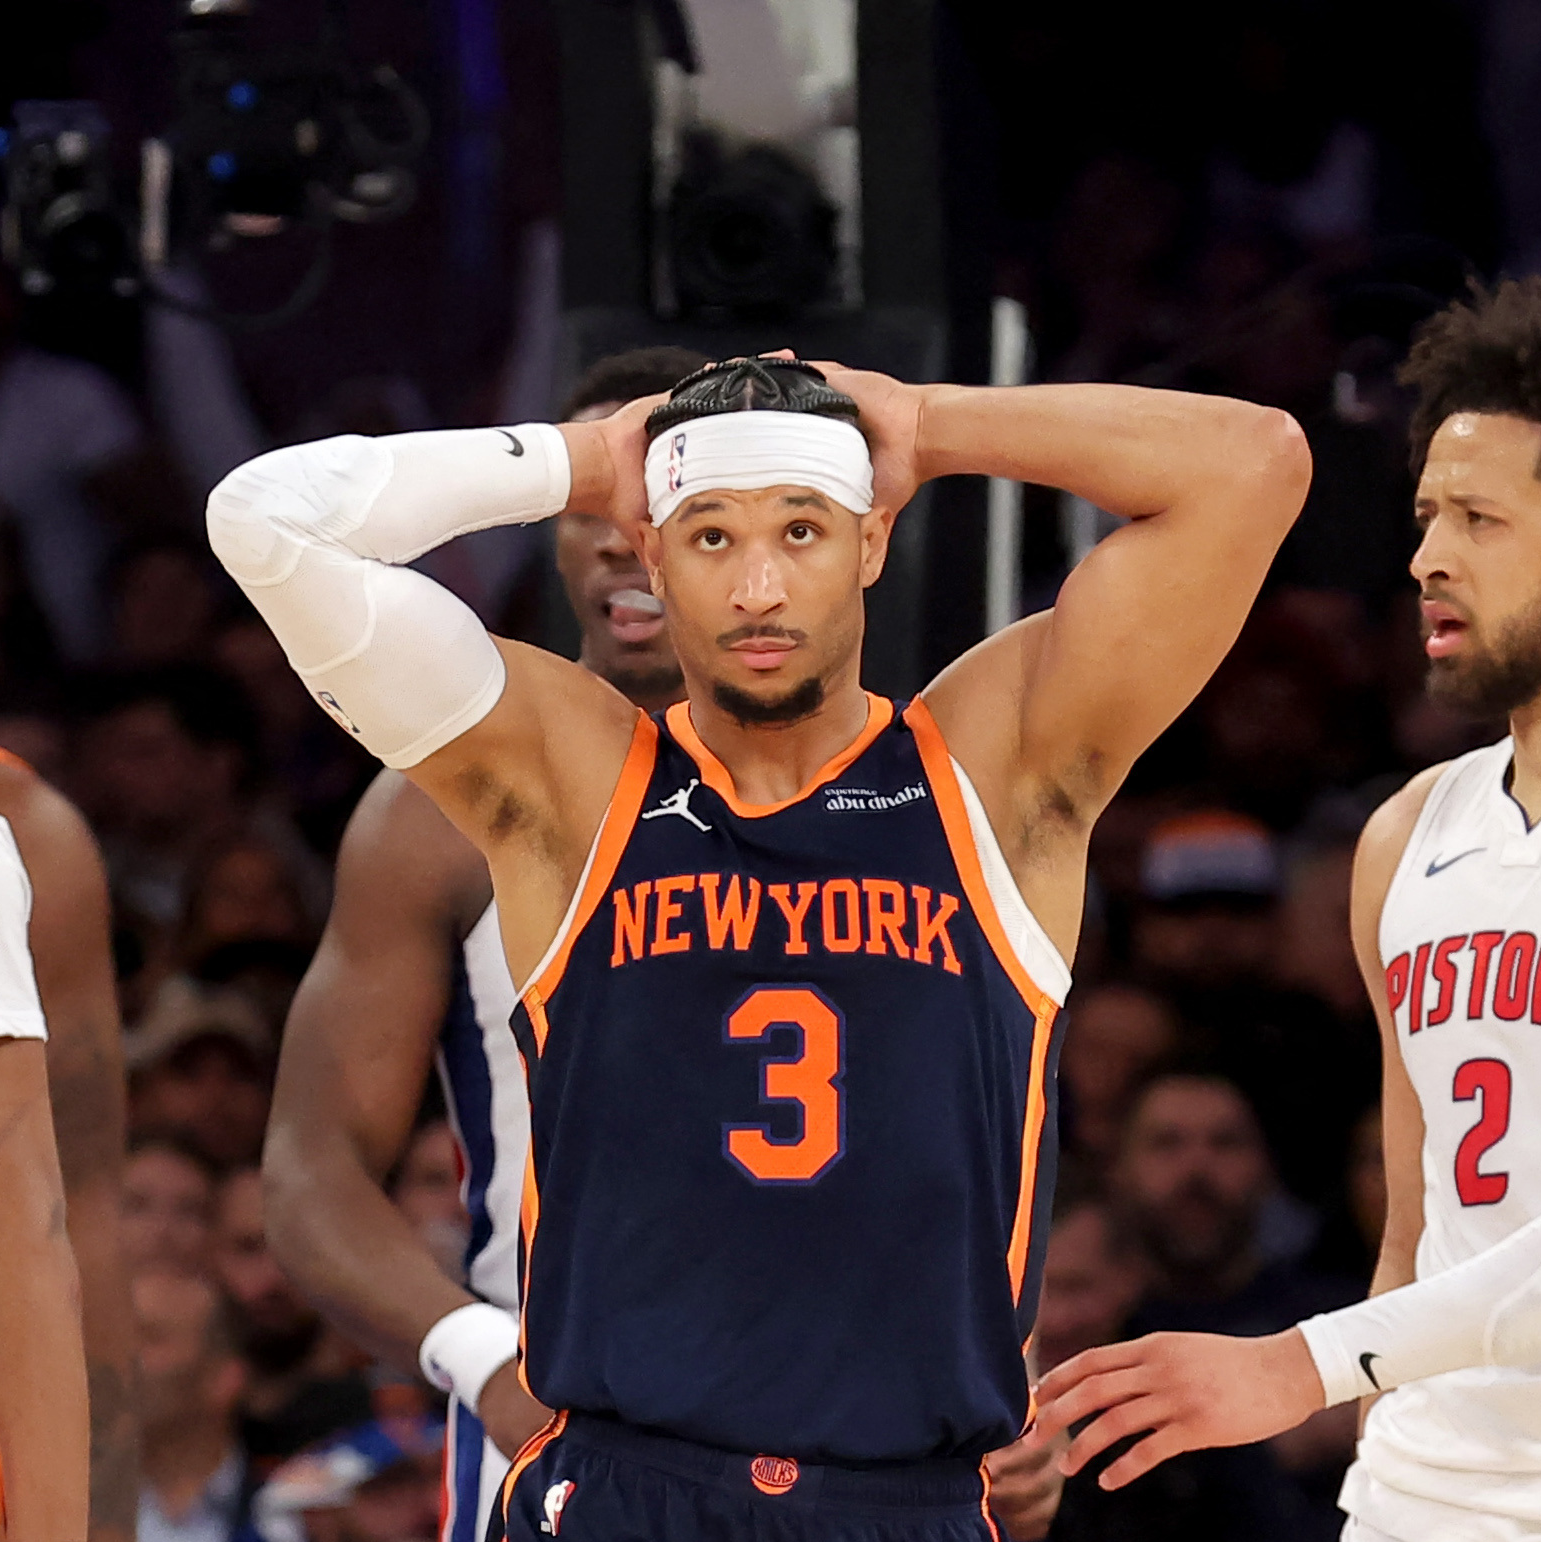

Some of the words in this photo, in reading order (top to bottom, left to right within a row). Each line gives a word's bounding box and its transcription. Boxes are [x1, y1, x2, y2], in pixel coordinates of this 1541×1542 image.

[825, 795, 867, 811] abu
[610, 872, 762, 968] NEW
[767, 877, 962, 976] YORK
[722, 982, 847, 1186] 3
[1452, 1058, 1512, 1207] 2
